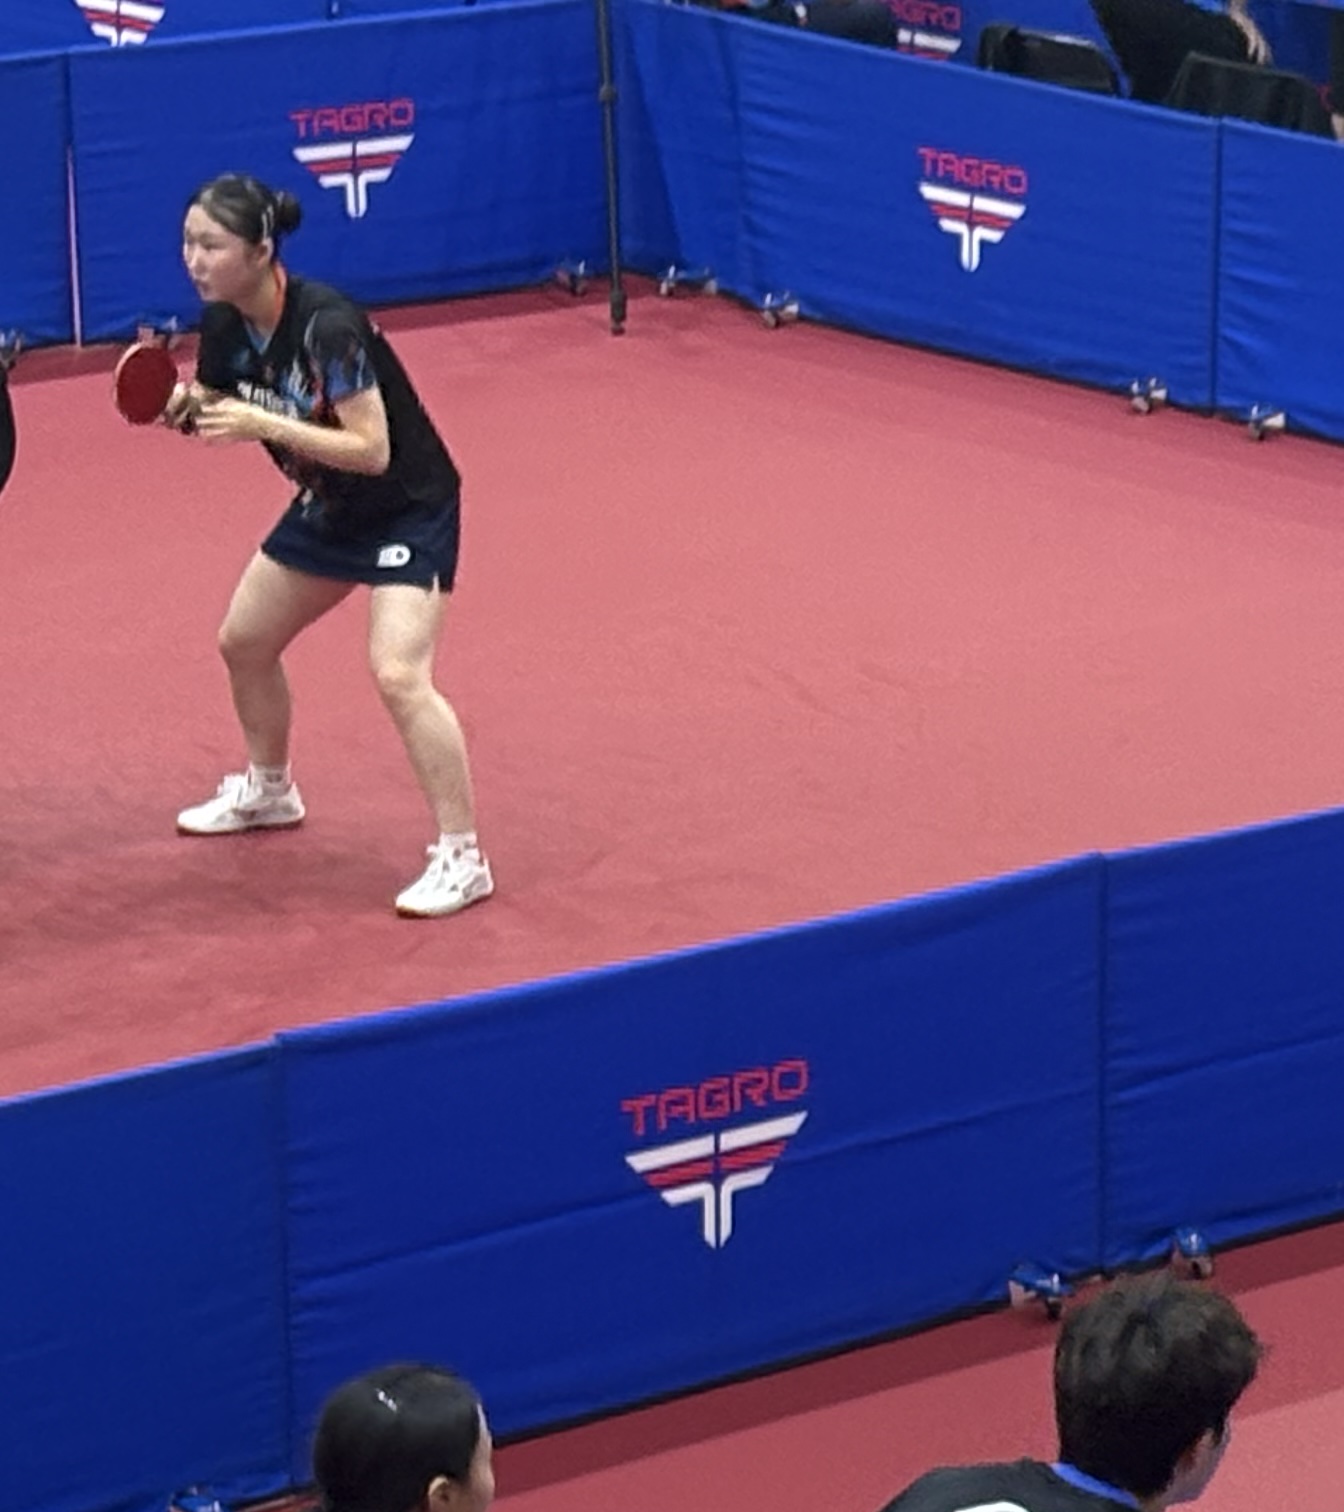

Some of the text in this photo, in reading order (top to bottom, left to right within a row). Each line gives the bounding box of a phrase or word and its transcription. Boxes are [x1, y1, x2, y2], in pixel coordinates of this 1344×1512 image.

[291, 98, 415, 138] TAGRO
[918, 147, 1027, 195] TAGRO
[621, 1059, 810, 1136] TAGRO
